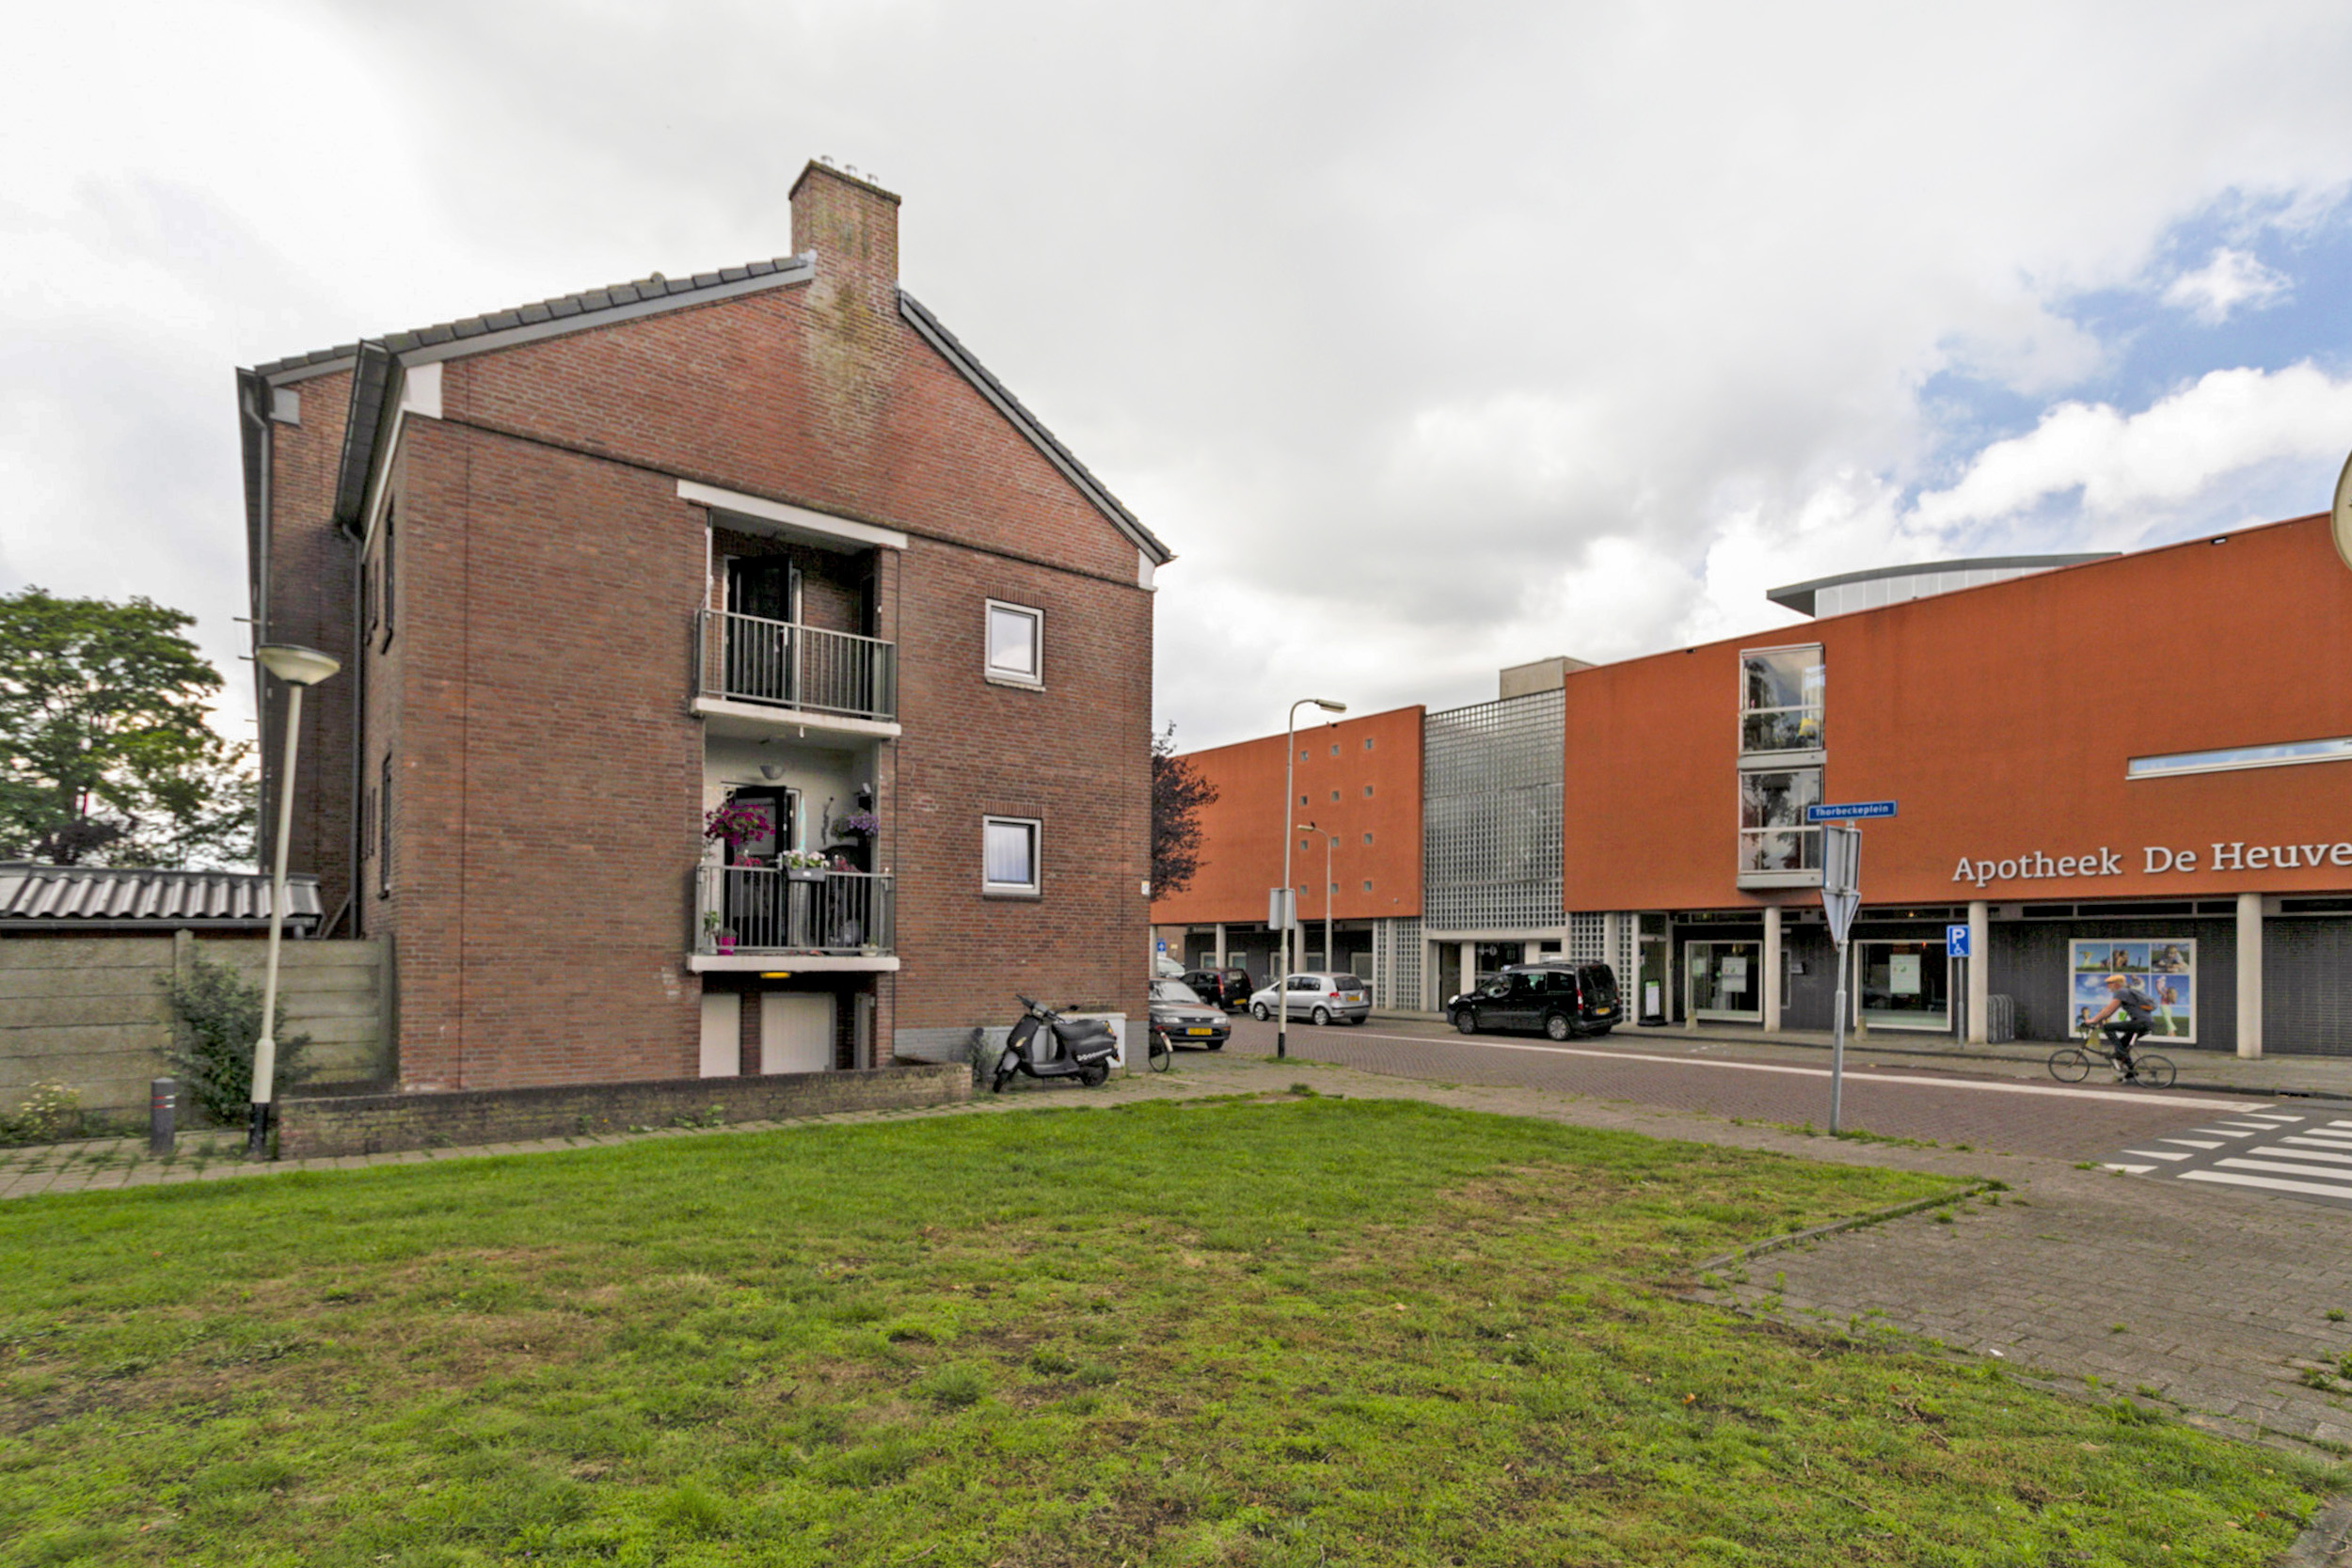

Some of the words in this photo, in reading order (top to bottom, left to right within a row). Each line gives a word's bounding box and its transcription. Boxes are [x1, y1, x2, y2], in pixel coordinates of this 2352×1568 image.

[1816, 805, 1889, 816] Thorbeckeplein
[1951, 847, 2122, 887] Apotheek
[2143, 846, 2197, 874] De
[1952, 927, 1966, 944] P
